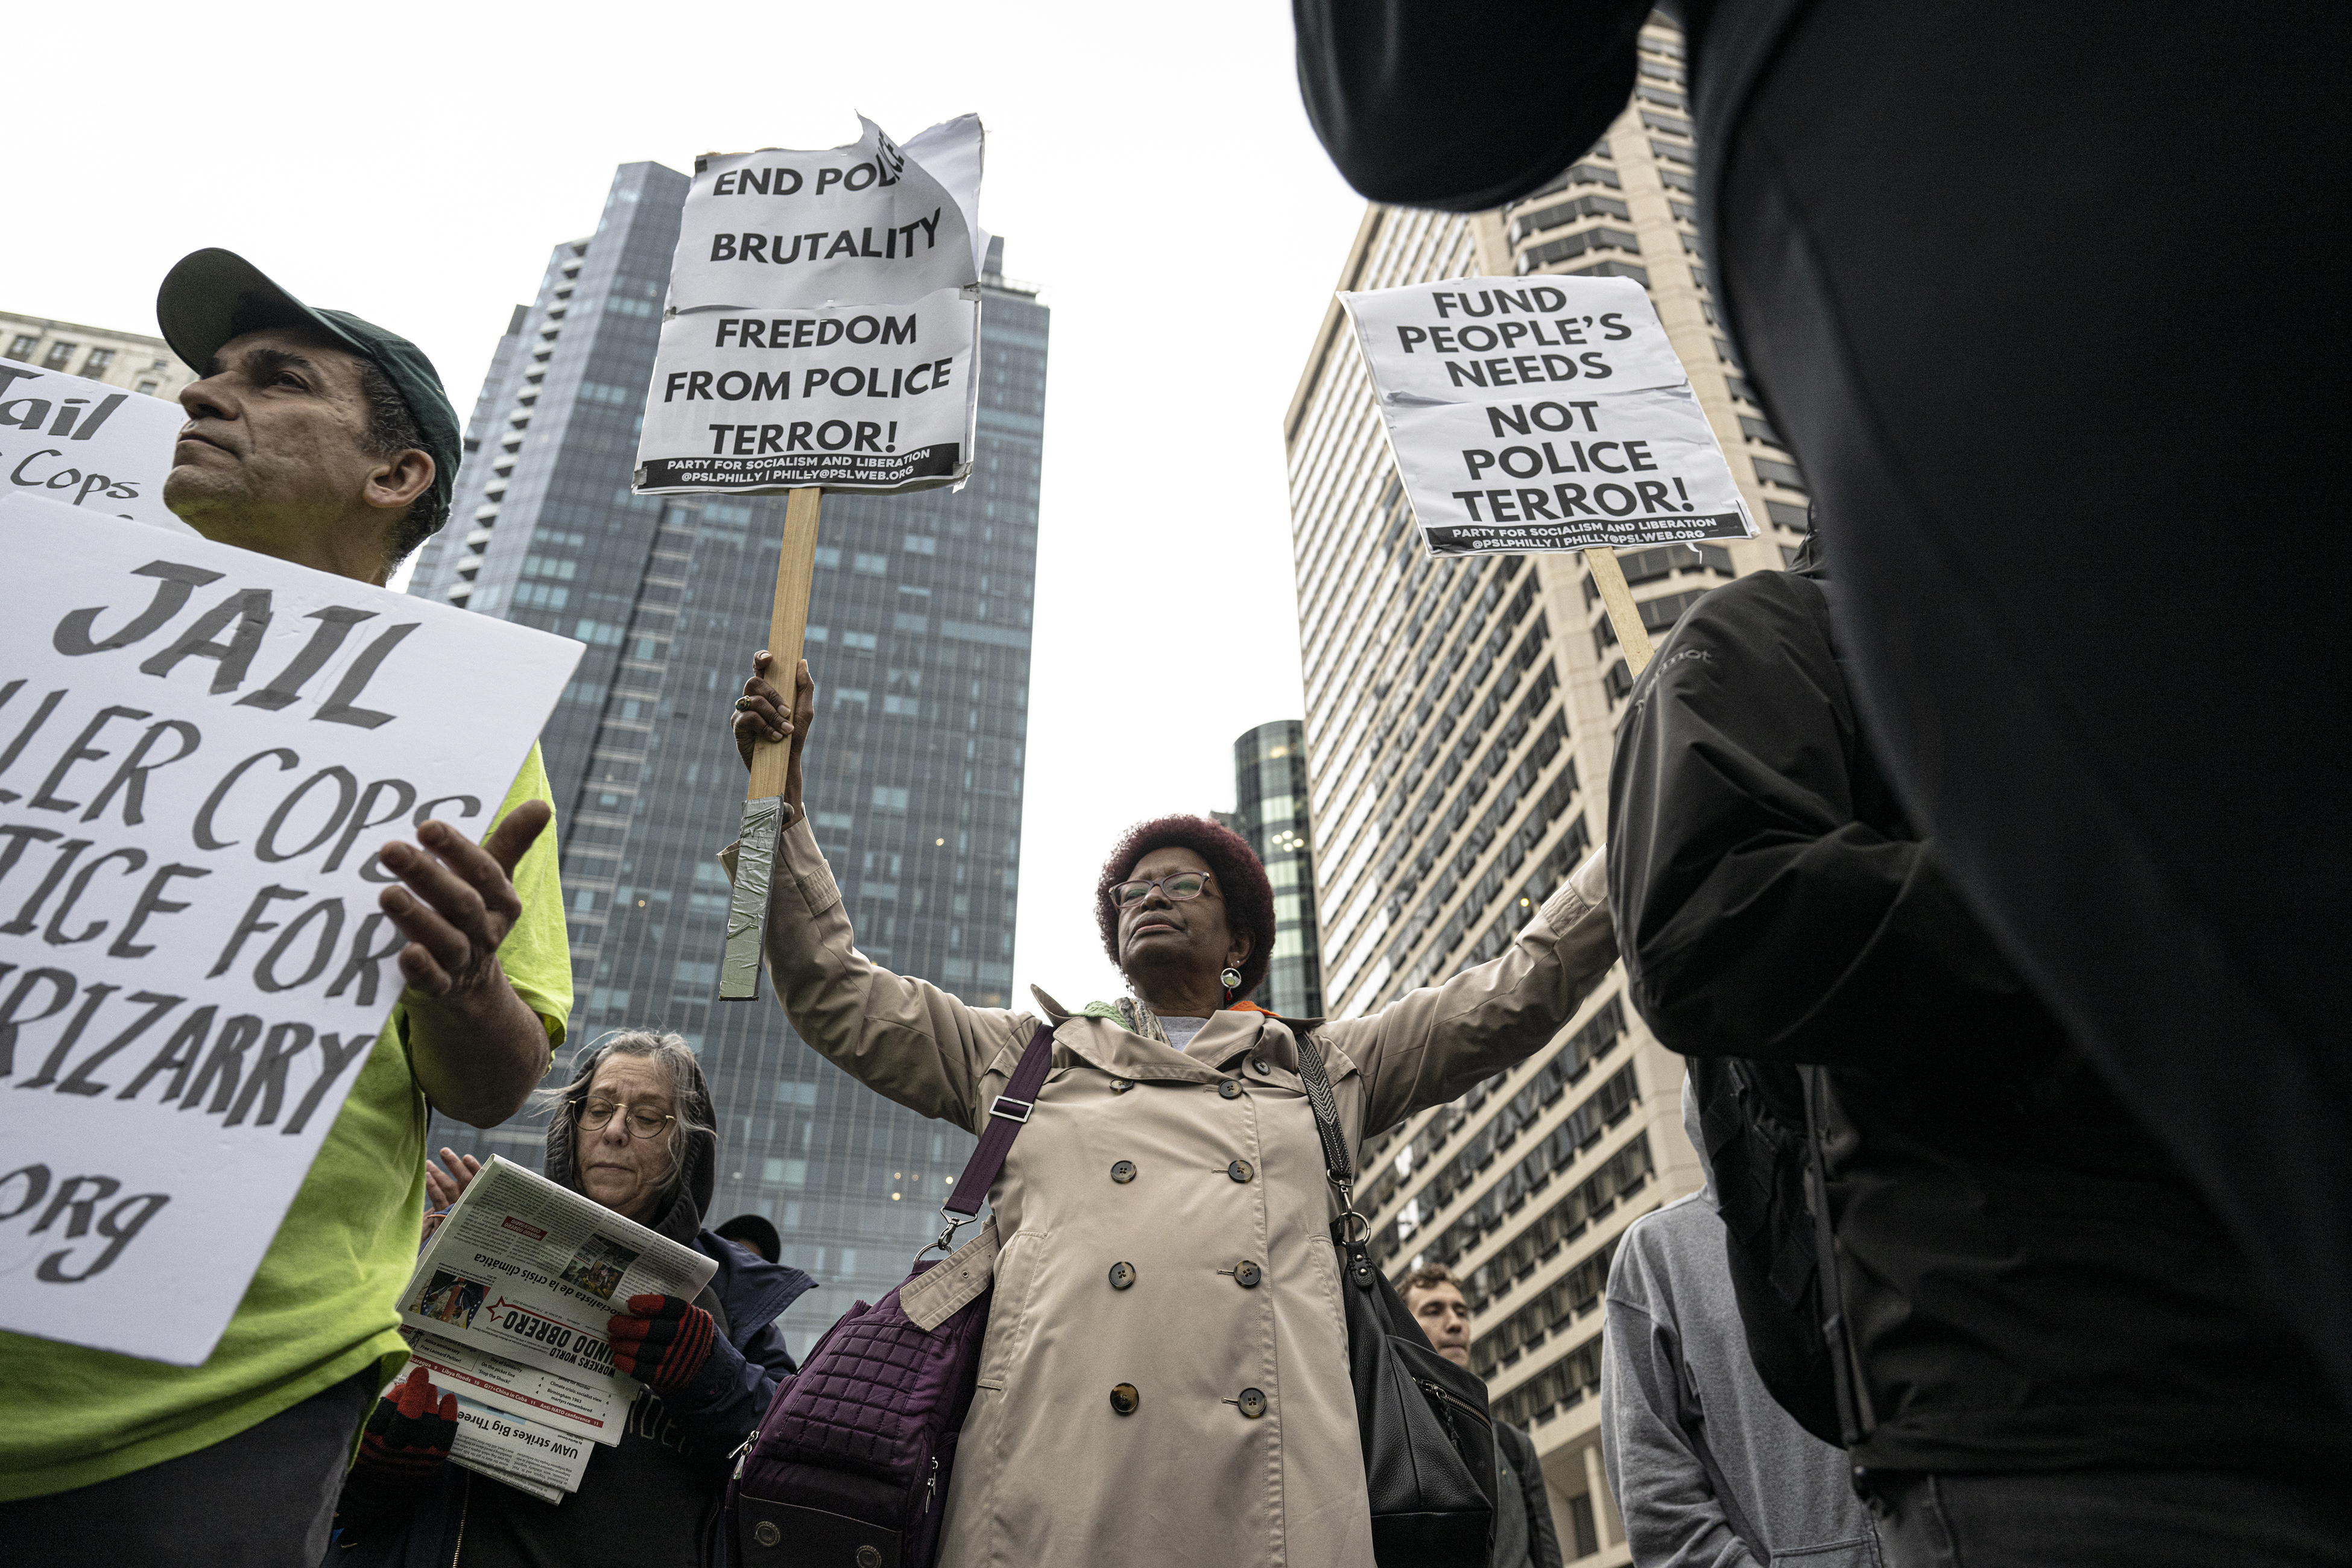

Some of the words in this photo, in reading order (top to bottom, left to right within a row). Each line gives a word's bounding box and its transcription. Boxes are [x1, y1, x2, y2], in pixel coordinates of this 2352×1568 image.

[713, 167, 803, 196] END
[710, 207, 941, 264] BRUTALITY
[1432, 286, 1566, 318] FUND
[715, 313, 917, 348] FREEDOM
[1397, 313, 1631, 353] PEOPLE'S
[664, 370, 791, 402] FROM
[803, 357, 953, 398] POLICE
[1444, 352, 1612, 387] NEEDS
[1486, 400, 1599, 437] NOT
[709, 420, 898, 455] TERROR!
[667, 460, 711, 470] PARTY
[714, 460, 742, 470] FOR
[745, 457, 817, 469] SOCIALISM
[821, 457, 852, 466] AND
[856, 449, 930, 467] LIBERATION
[1462, 440, 1658, 480] POLICE
[10, 449, 141, 506] Cops
[681, 472, 763, 482] @PSLPHILLY
[773, 466, 914, 480] PHILLY@PSLWEB.ORG
[1452, 477, 1694, 522] TERROR!
[1452, 529, 1494, 537] PARTY
[1499, 528, 1527, 537] FOR
[1529, 522, 1604, 536] SOCIALISM
[1607, 523, 1635, 533] AND
[1638, 518, 1717, 530] LIBERATION
[1472, 538, 1552, 549] @PSLPHILLY
[1563, 530, 1705, 546] PHILLY@PSLWEB.ORG
[52, 560, 422, 730] JAIL
[205, 884, 412, 1007] FOR
[0, 961, 376, 1135] RIZARRY
[504, 1222, 523, 1232] OBRERO
[511, 1219, 540, 1233] COMENTARIO
[523, 1230, 541, 1239] MUNDO
[474, 1253, 520, 1275] climática
[520, 1269, 547, 1284] crisis
[549, 1280, 560, 1291] la
[560, 1285, 574, 1295] de
[575, 1292, 622, 1315] socialista
[503, 1311, 571, 1347] OBRERO
[429, 1348, 447, 1357] Leonard
[446, 1354, 461, 1362] Peltier!
[436, 1343, 460, 1355] anniversary
[549, 1347, 577, 1364] WORLD
[573, 1336, 618, 1365] UNDO
[503, 1361, 523, 1372] Solidarity
[578, 1358, 616, 1377] WORKERS
[409, 1356, 431, 1367] icaragua
[441, 1368, 455, 1376] Libya
[455, 1373, 470, 1382] floods
[484, 1383, 509, 1396] G77+China
[540, 1403, 564, 1414] Anti-NATO
[565, 1412, 590, 1423] conference
[547, 1388, 571, 1399] Birmingham
[550, 1380, 564, 1389] Climate
[566, 1402, 592, 1412] remembered
[456, 1411, 488, 1430] Three
[492, 1420, 511, 1437] Big
[513, 1429, 550, 1447] strikes
[550, 1443, 577, 1458] UAW
